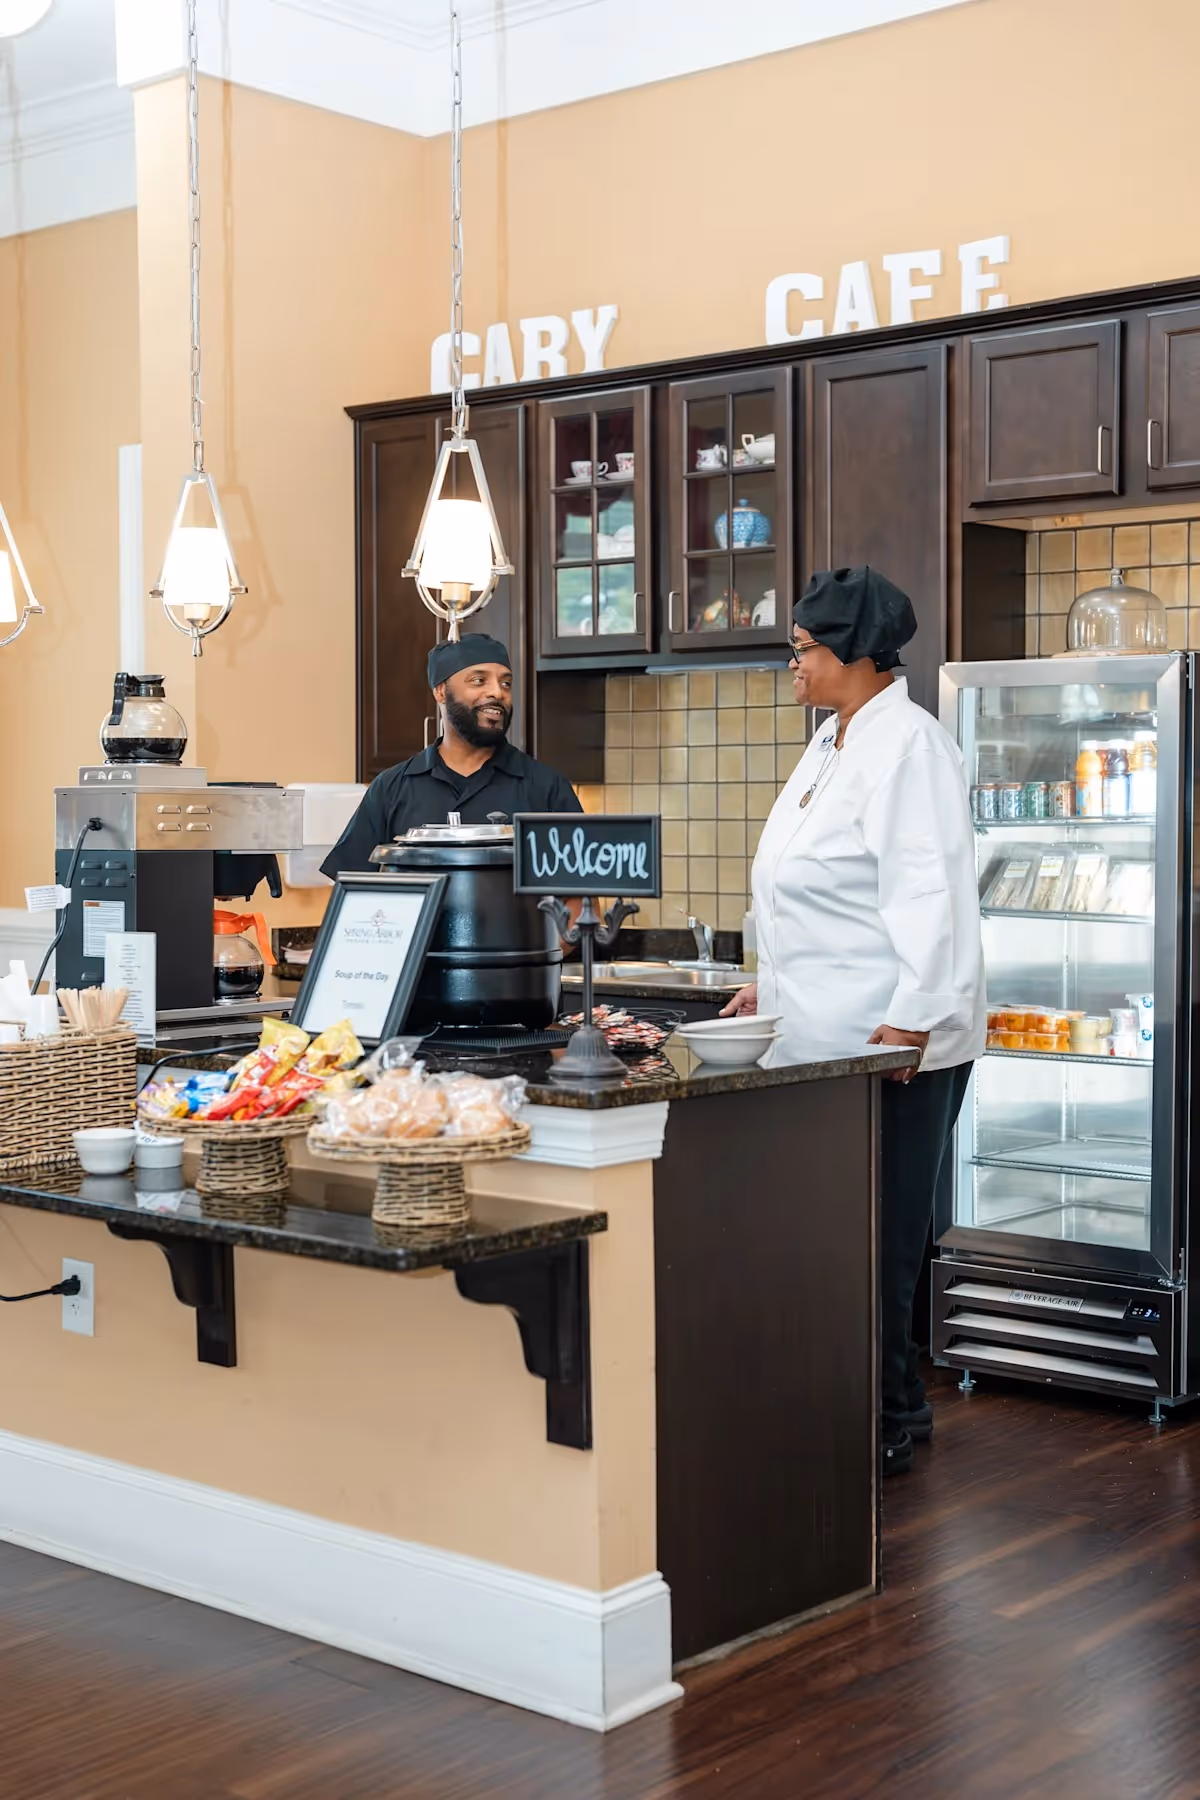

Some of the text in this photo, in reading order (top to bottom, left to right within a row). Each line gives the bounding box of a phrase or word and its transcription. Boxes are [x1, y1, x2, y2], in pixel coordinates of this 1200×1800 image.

[430, 235, 1010, 396] CARY CAFE
[527, 827, 649, 879] Welcome
[334, 969, 389, 983] Soup of the Day
[1023, 1293, 1079, 1307] BEVERAGE-AIR
